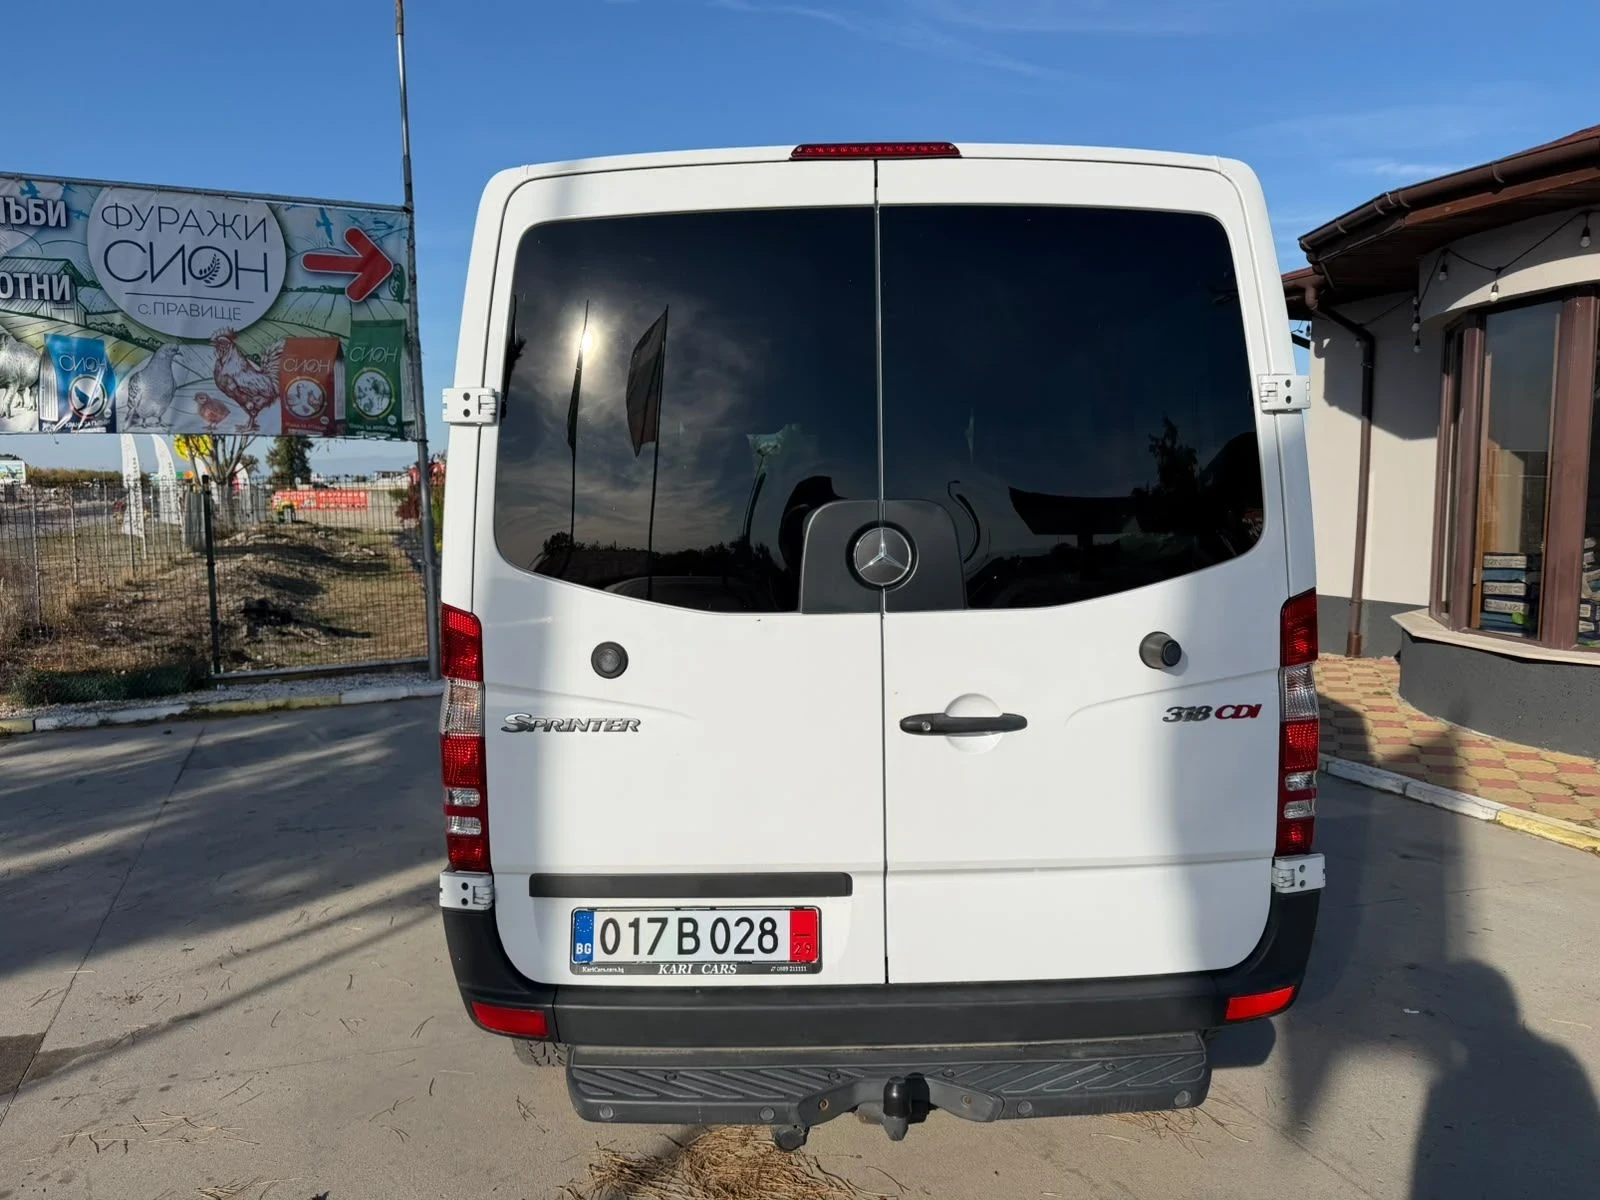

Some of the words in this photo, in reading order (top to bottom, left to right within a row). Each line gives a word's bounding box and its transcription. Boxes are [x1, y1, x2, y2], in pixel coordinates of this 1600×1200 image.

[0, 197, 67, 228] ЪБИ
[101, 202, 268, 243] ФУРАЖИ
[103, 239, 269, 293] СИОН
[59, 354, 108, 373] СИОН
[349, 345, 398, 364] СИОН
[283, 357, 331, 374] СИОН
[1162, 705, 1212, 723] 318
[1214, 703, 1262, 720] CDI
[575, 943, 592, 955] BG
[658, 963, 693, 975] KARI
[701, 963, 737, 975] CARS
